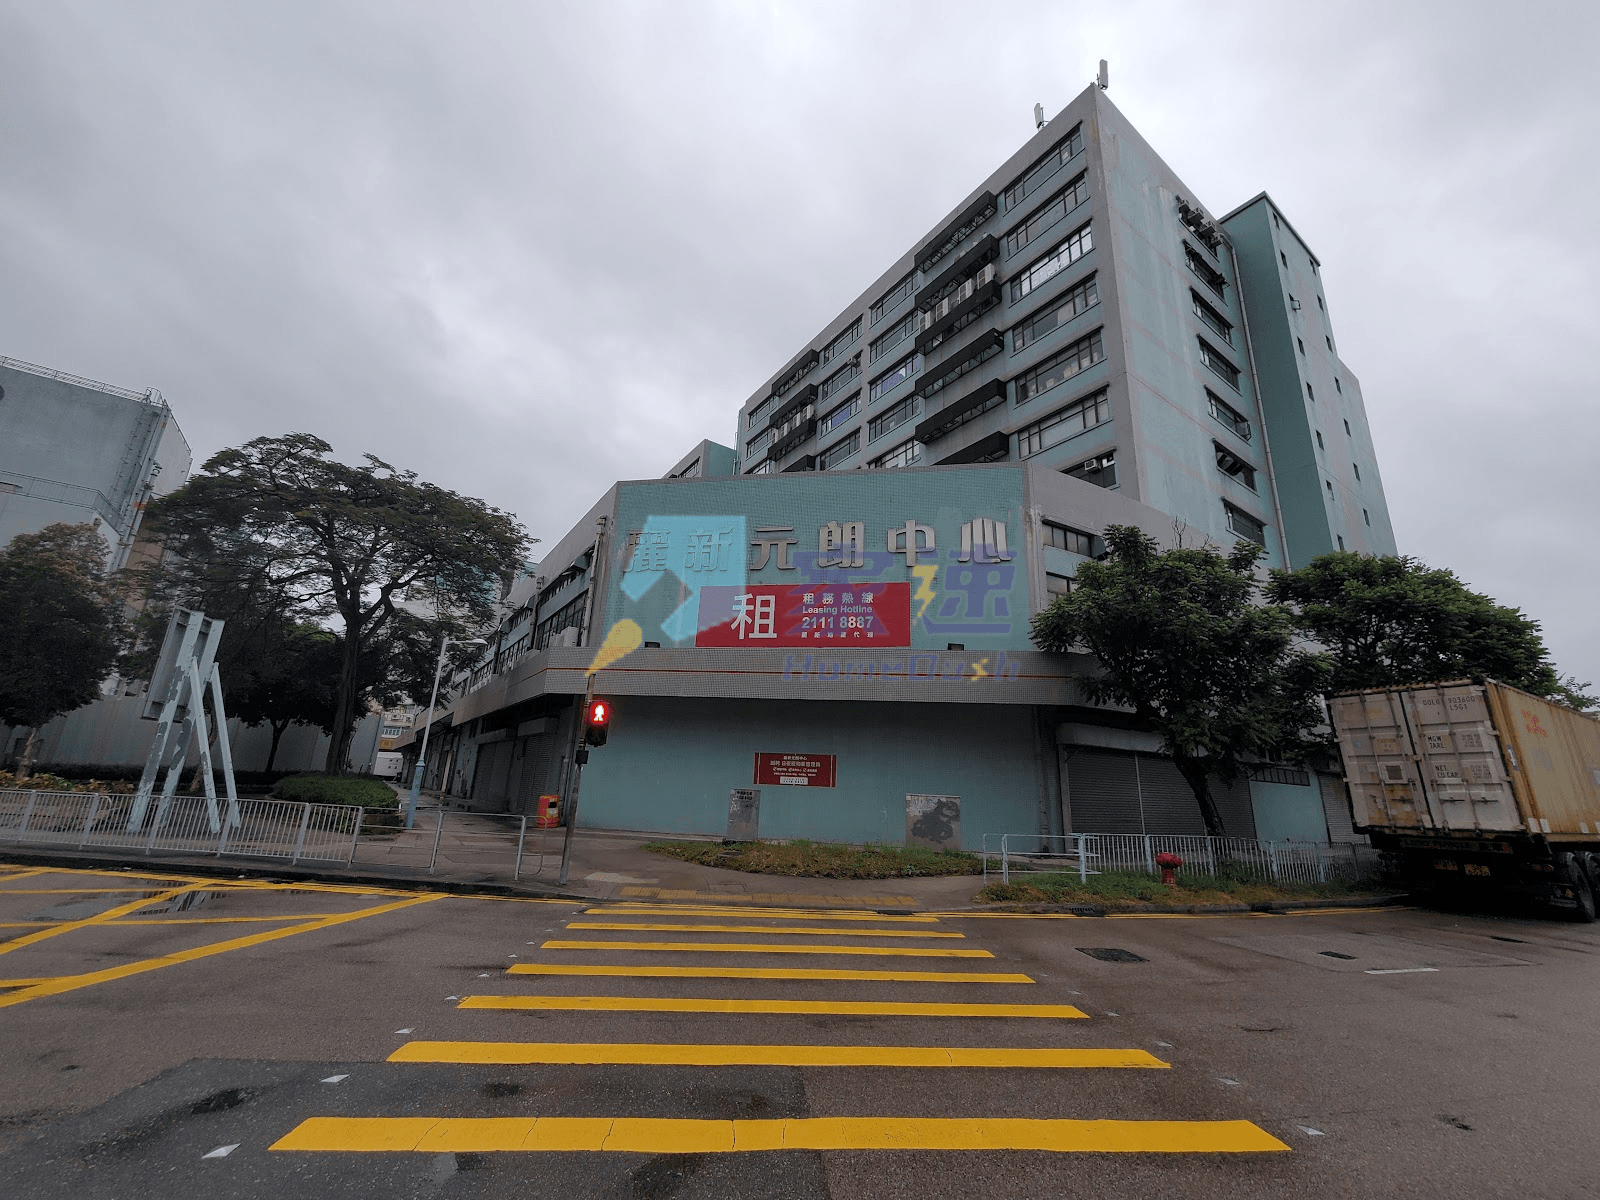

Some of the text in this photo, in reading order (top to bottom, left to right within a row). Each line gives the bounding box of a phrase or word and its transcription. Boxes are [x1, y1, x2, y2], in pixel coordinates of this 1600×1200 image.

[623, 517, 1012, 572] 麗新元朗中心
[802, 592, 874, 605] 租務熱線
[730, 593, 778, 640] 租
[802, 605, 873, 615] Leasing Hotline
[802, 616, 874, 629] 2111 8887
